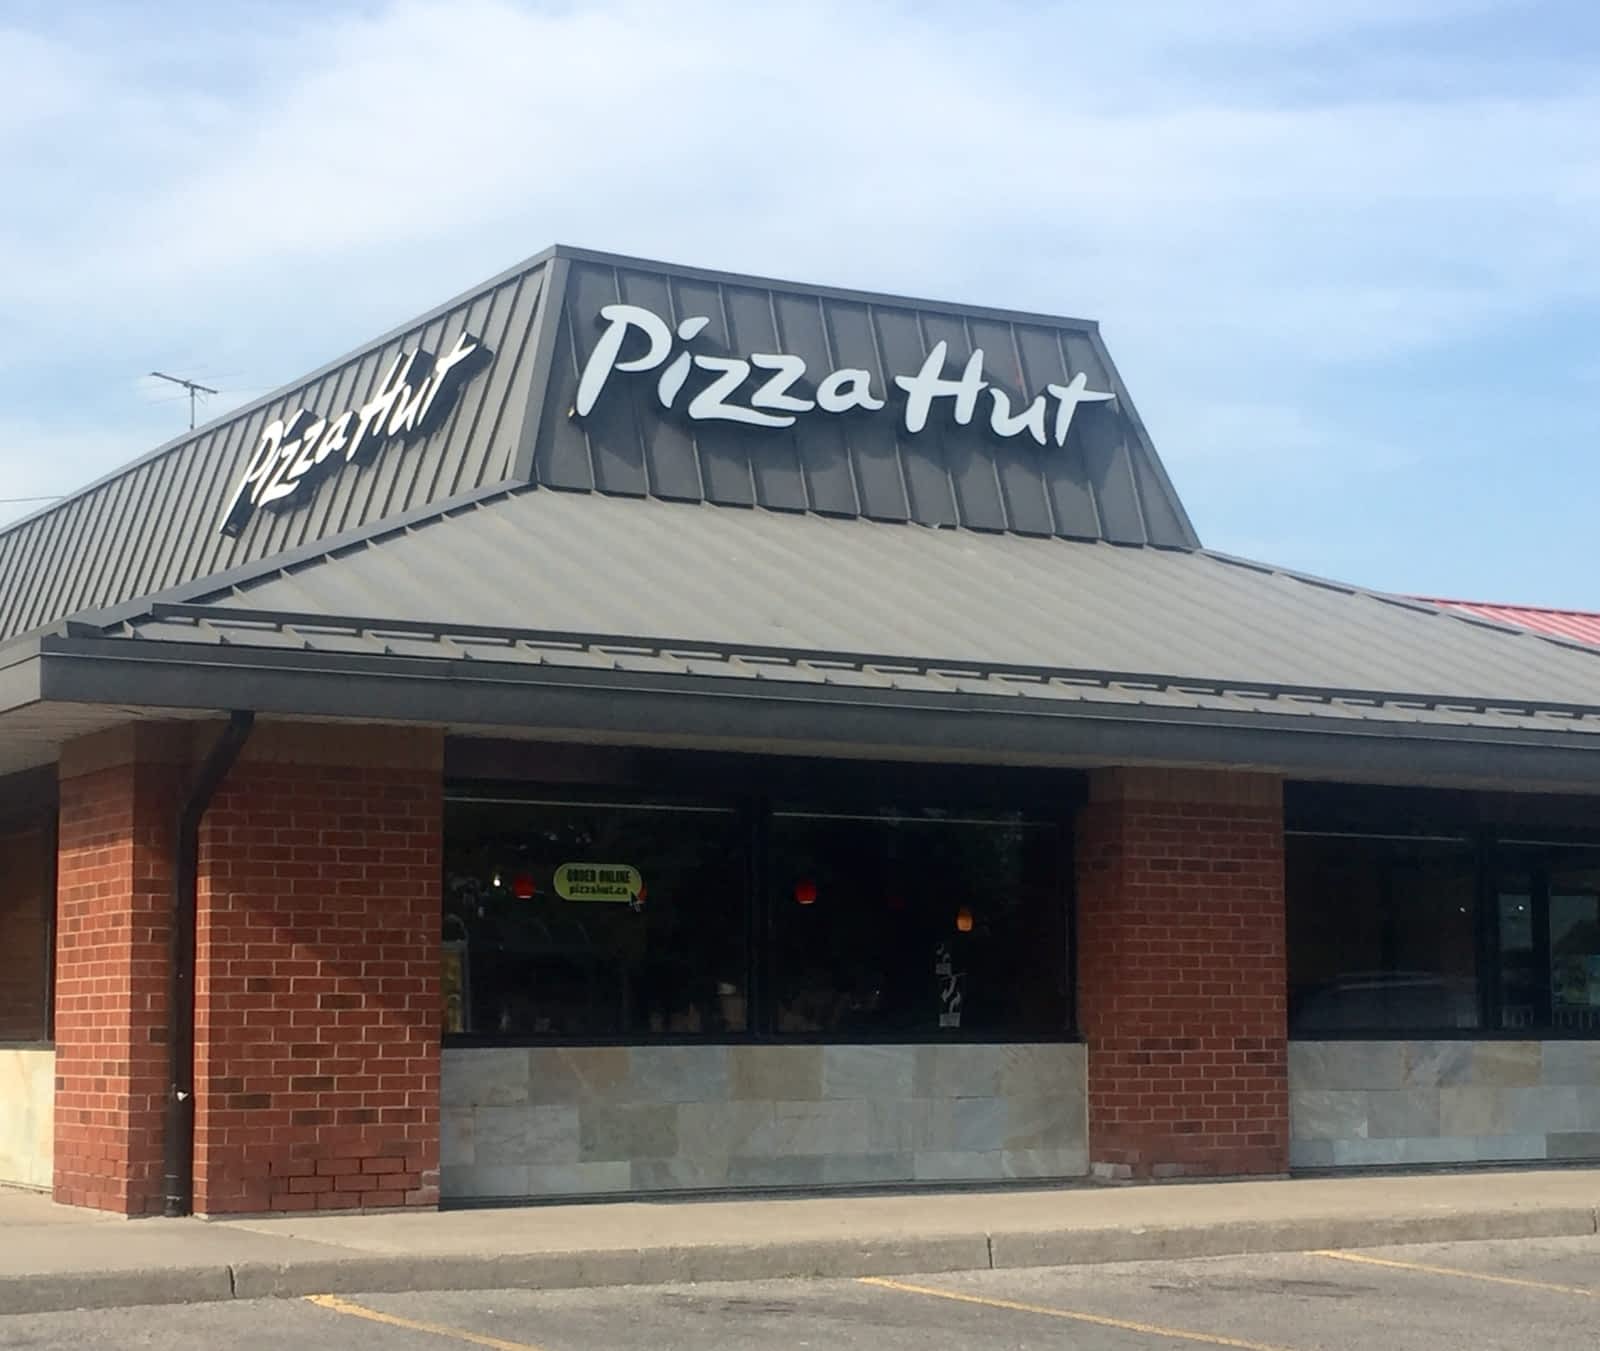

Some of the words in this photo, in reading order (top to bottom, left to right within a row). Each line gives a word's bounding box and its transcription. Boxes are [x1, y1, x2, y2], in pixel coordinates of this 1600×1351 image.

[218, 408, 353, 534] Pizza
[345, 331, 477, 463] Hut
[575, 303, 886, 428] Pizza
[894, 340, 1116, 447] Hut
